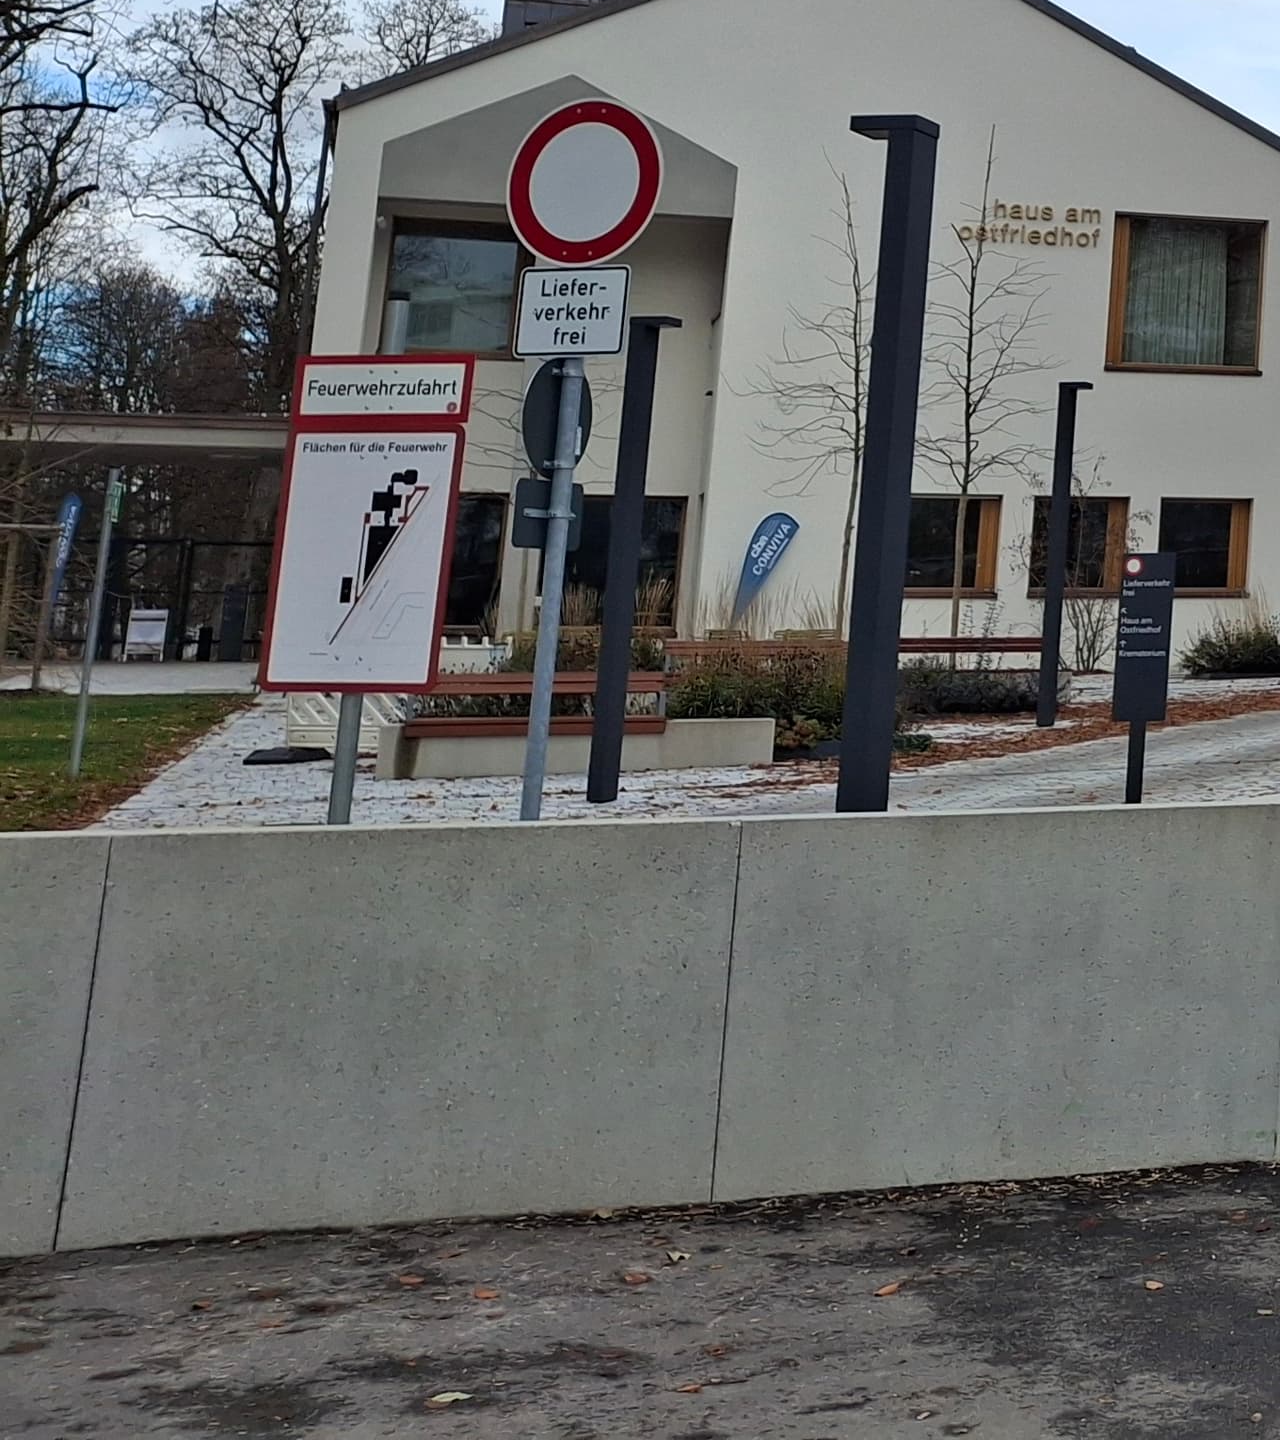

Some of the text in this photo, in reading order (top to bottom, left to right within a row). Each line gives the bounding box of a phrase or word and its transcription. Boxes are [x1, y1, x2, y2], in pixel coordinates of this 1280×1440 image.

[994, 198, 1101, 224] haus am
[959, 223, 1101, 248] ostfriedhof
[541, 278, 607, 297] Liefer-
[534, 302, 610, 321] verkehr
[553, 326, 586, 345] frei
[308, 379, 457, 397] Feuerwehrzufahrt
[302, 442, 448, 454] Flächen für die Feuerwehr
[752, 523, 791, 576] CONVIVA
[1122, 589, 1135, 597] frei
[1123, 580, 1171, 588] Lieferverkehr
[1120, 625, 1162, 634] Ostfriedhof
